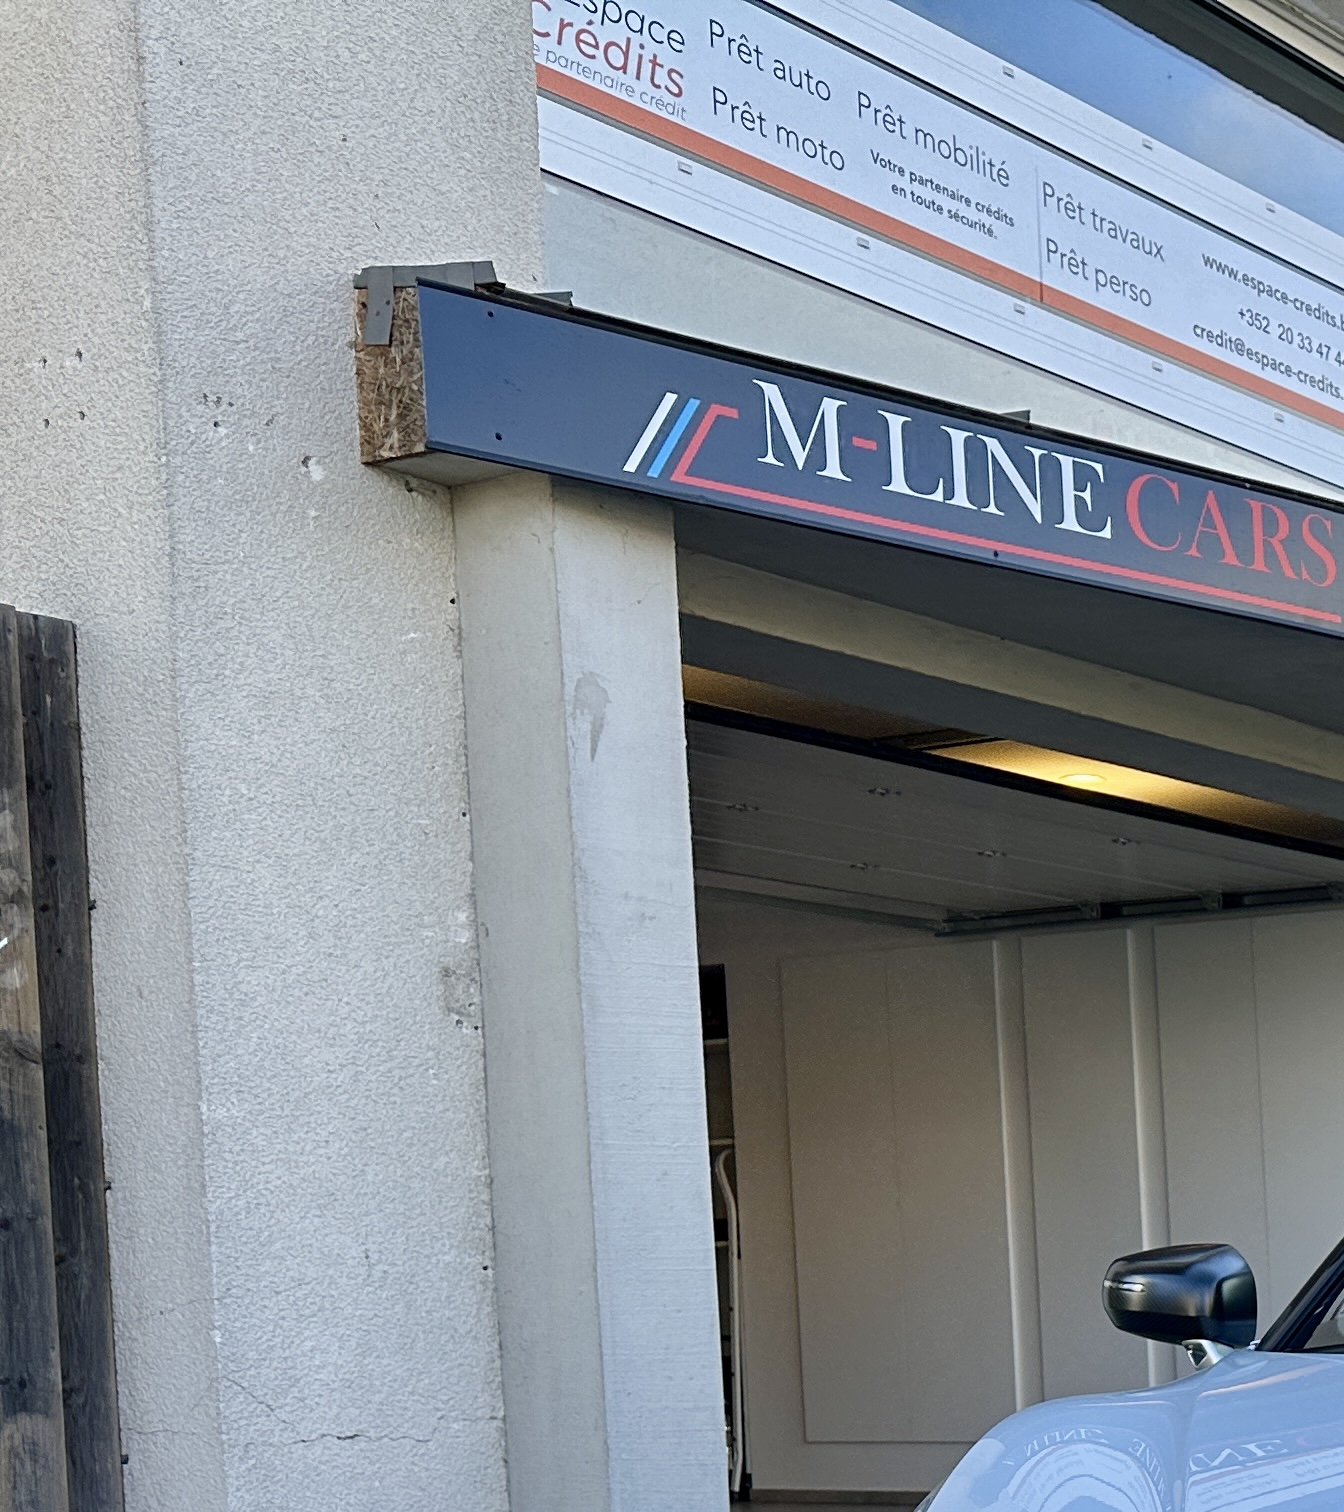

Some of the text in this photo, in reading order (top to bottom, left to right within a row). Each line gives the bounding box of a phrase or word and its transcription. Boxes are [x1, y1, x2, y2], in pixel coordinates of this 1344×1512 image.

[564, 0, 686, 53] space
[709, 18, 831, 101] Prêt auto
[546, 50, 687, 121] partenaire crédit
[712, 86, 844, 171] Prêt moto
[857, 91, 1010, 188] Prêt mobilité
[870, 148, 1015, 228] Votre partenaire crédits
[891, 183, 998, 239] en toute sécurité.
[1042, 181, 1165, 262] Prêt travaux
[1046, 238, 1152, 307] Prêt perso
[1237, 307, 1271, 335] +352
[1277, 323, 1294, 345] 20
[1297, 332, 1313, 353] 33
[1316, 342, 1331, 361] 47
[752, 379, 1337, 588] M-LINE CARS
